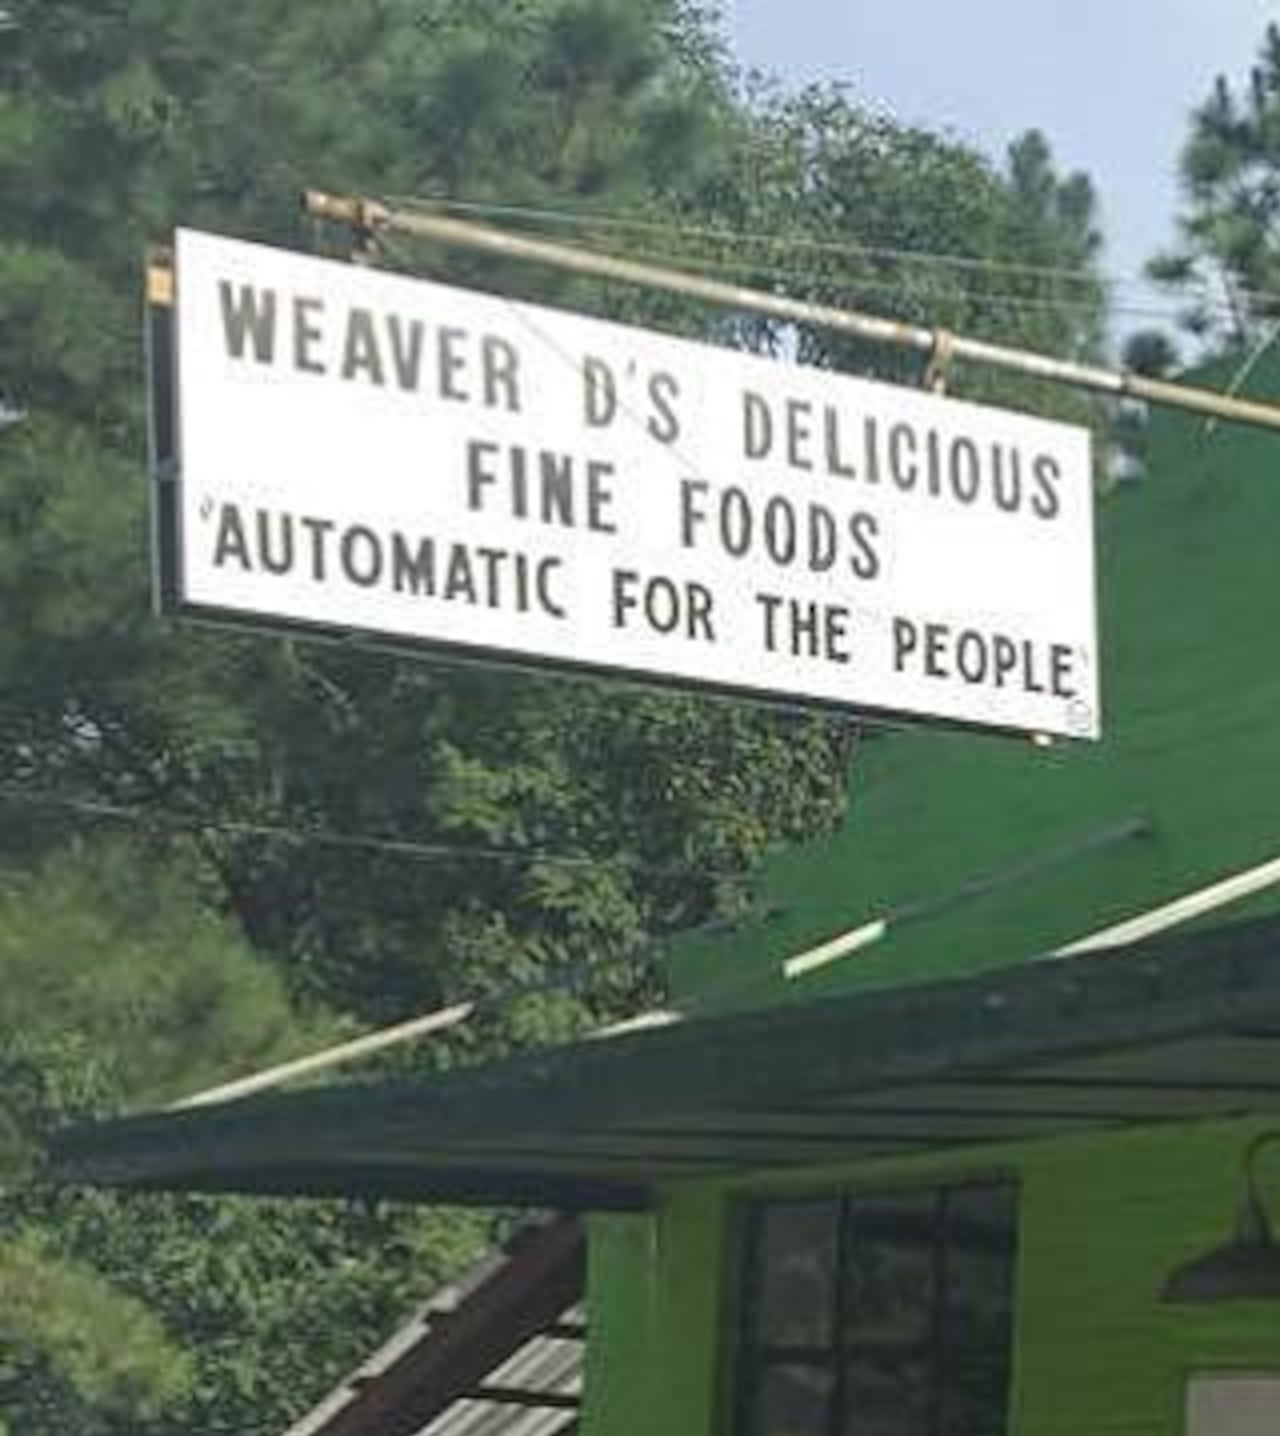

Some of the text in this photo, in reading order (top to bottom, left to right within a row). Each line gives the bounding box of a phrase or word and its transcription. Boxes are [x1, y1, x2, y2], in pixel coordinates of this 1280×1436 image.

[218, 279, 1062, 520] WEAVER D'S DELICIOUS
[467, 438, 880, 580] FINE FOODS
[612, 568, 716, 643] FOR
[755, 592, 850, 664] THE
